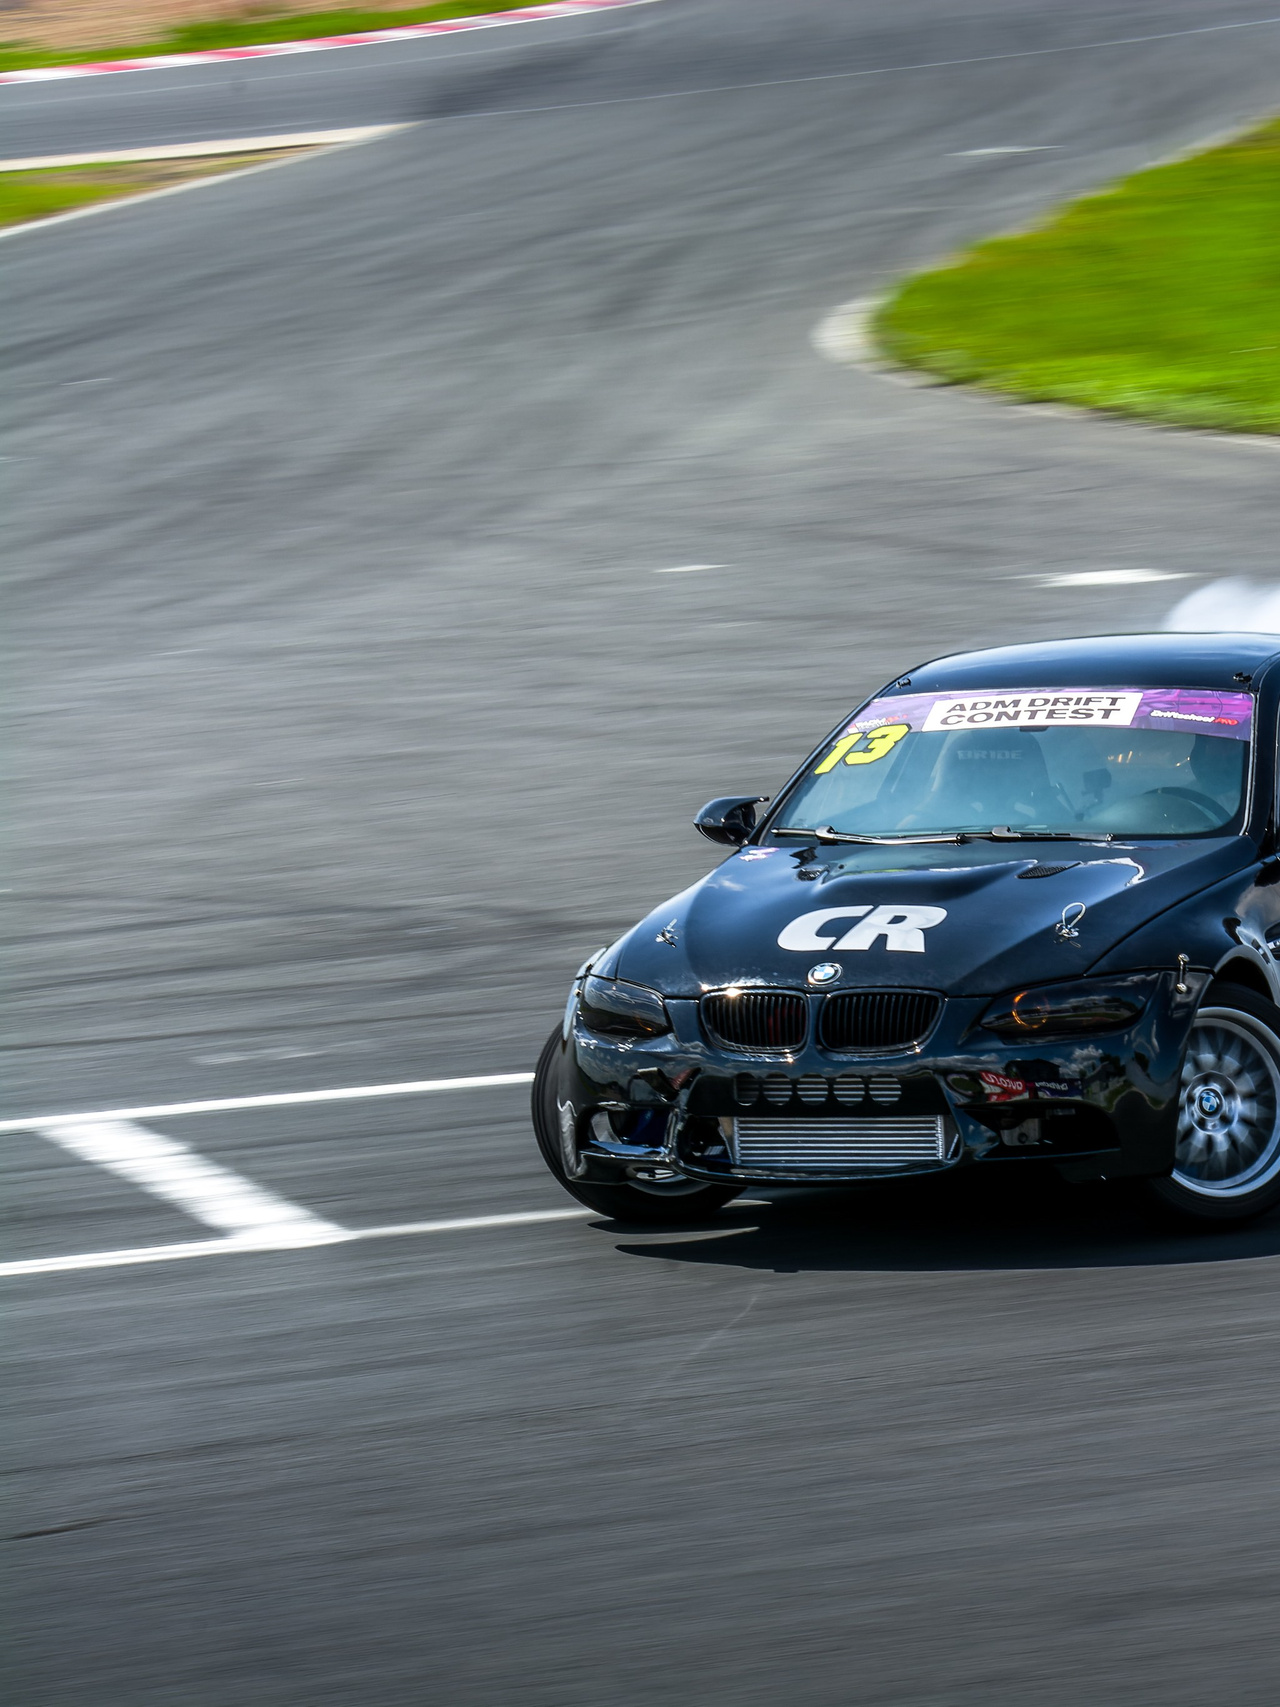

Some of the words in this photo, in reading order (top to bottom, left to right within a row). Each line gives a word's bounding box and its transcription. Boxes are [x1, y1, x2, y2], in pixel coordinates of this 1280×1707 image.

[940, 708, 1121, 726] CONTEST
[946, 698, 1022, 714] ADM
[1027, 696, 1126, 708] DRIFT
[813, 723, 912, 775] 13
[777, 904, 948, 953] CR
